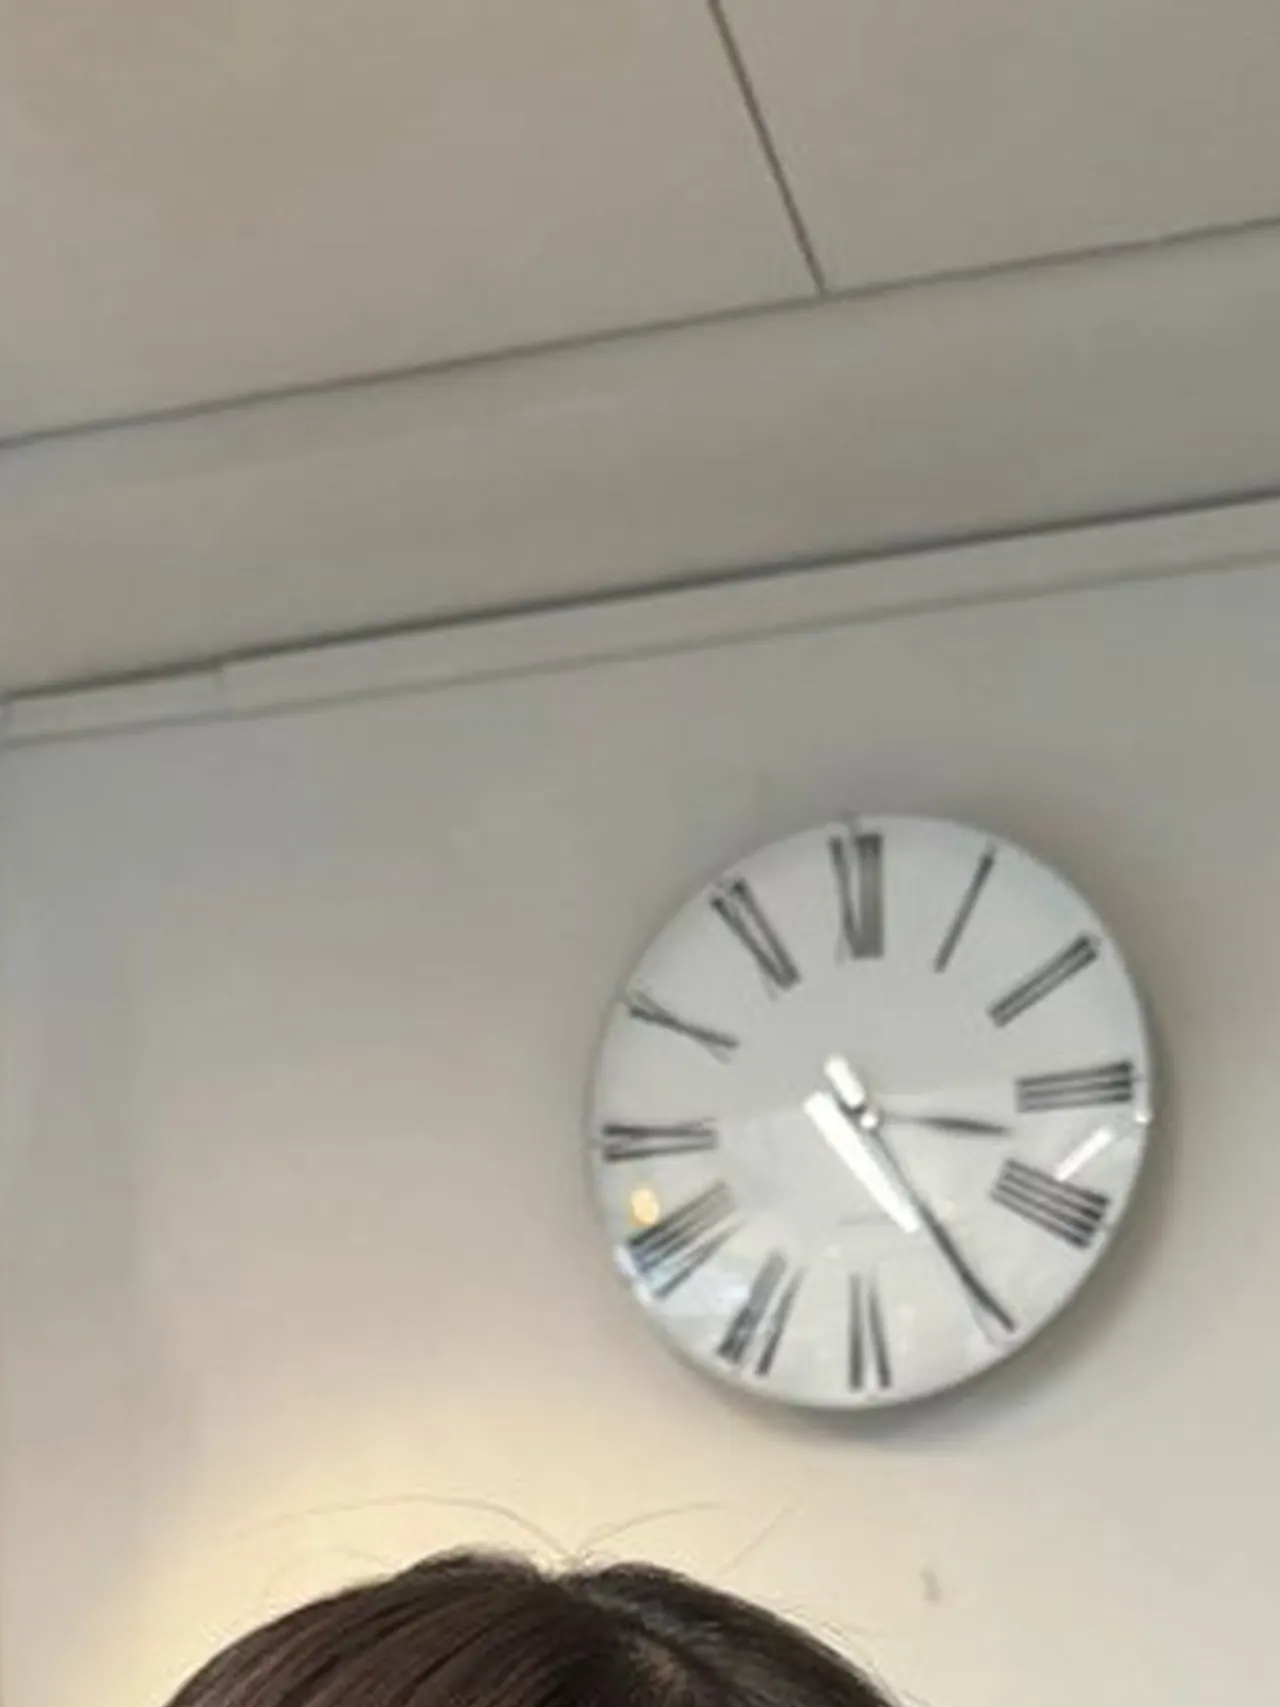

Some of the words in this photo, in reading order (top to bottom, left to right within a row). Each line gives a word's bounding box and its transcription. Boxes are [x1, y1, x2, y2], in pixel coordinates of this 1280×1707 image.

[827, 828, 884, 963] XII
[933, 848, 995, 974] I
[986, 932, 1099, 1028] II
[1014, 1060, 1133, 1113] III
